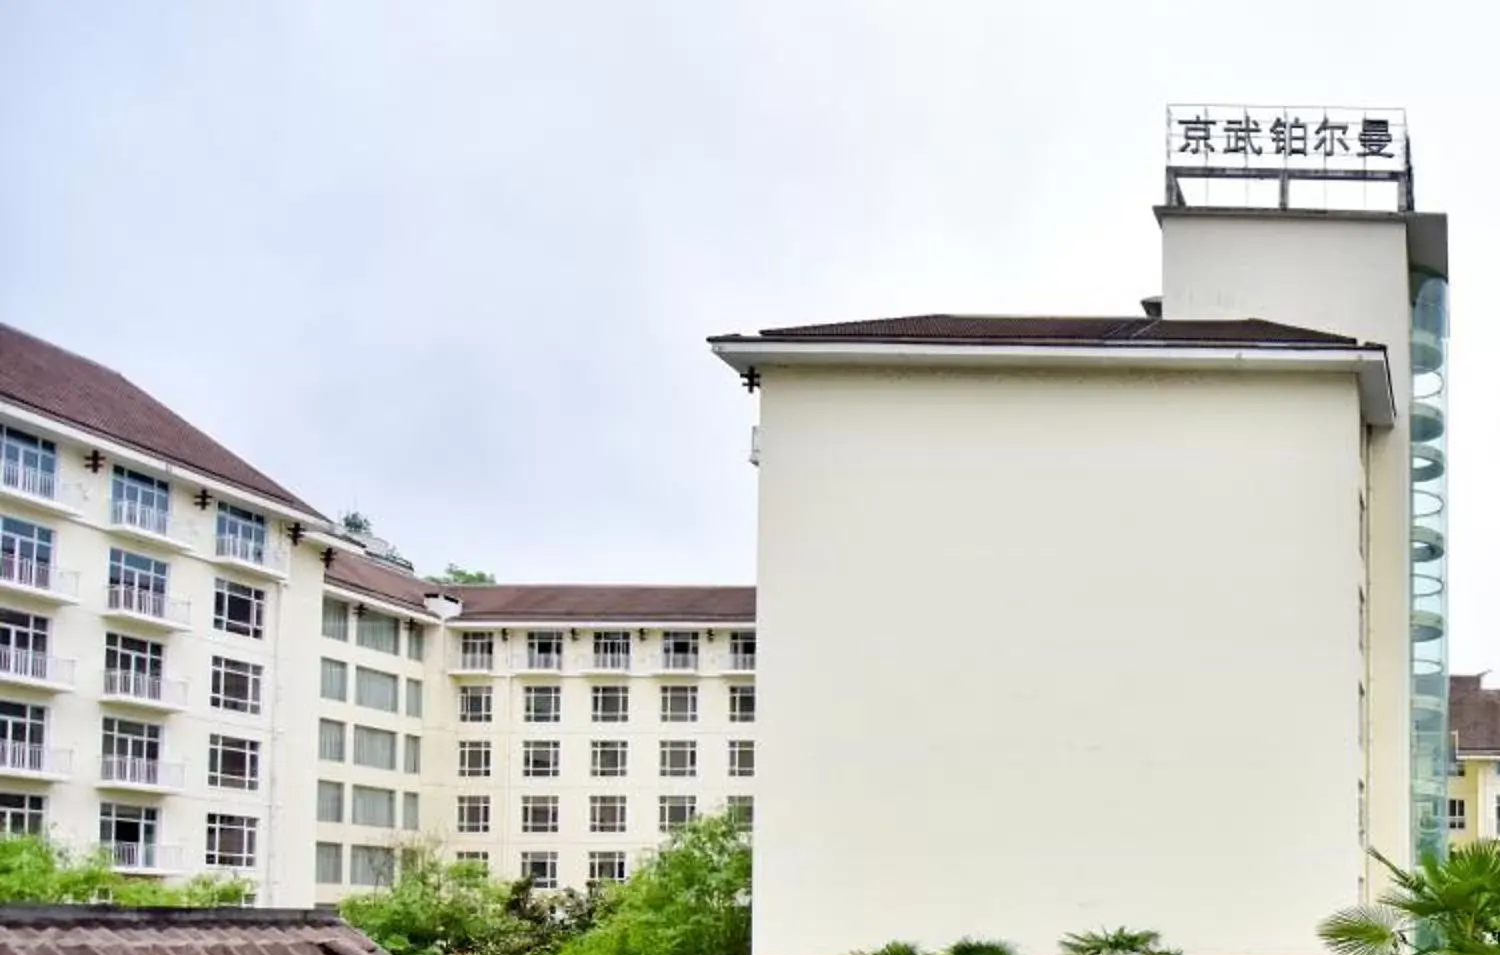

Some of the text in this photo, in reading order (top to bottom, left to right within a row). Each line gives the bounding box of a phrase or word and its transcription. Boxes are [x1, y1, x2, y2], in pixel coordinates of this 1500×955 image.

[1178, 115, 1394, 158] 京武铂尔曼
